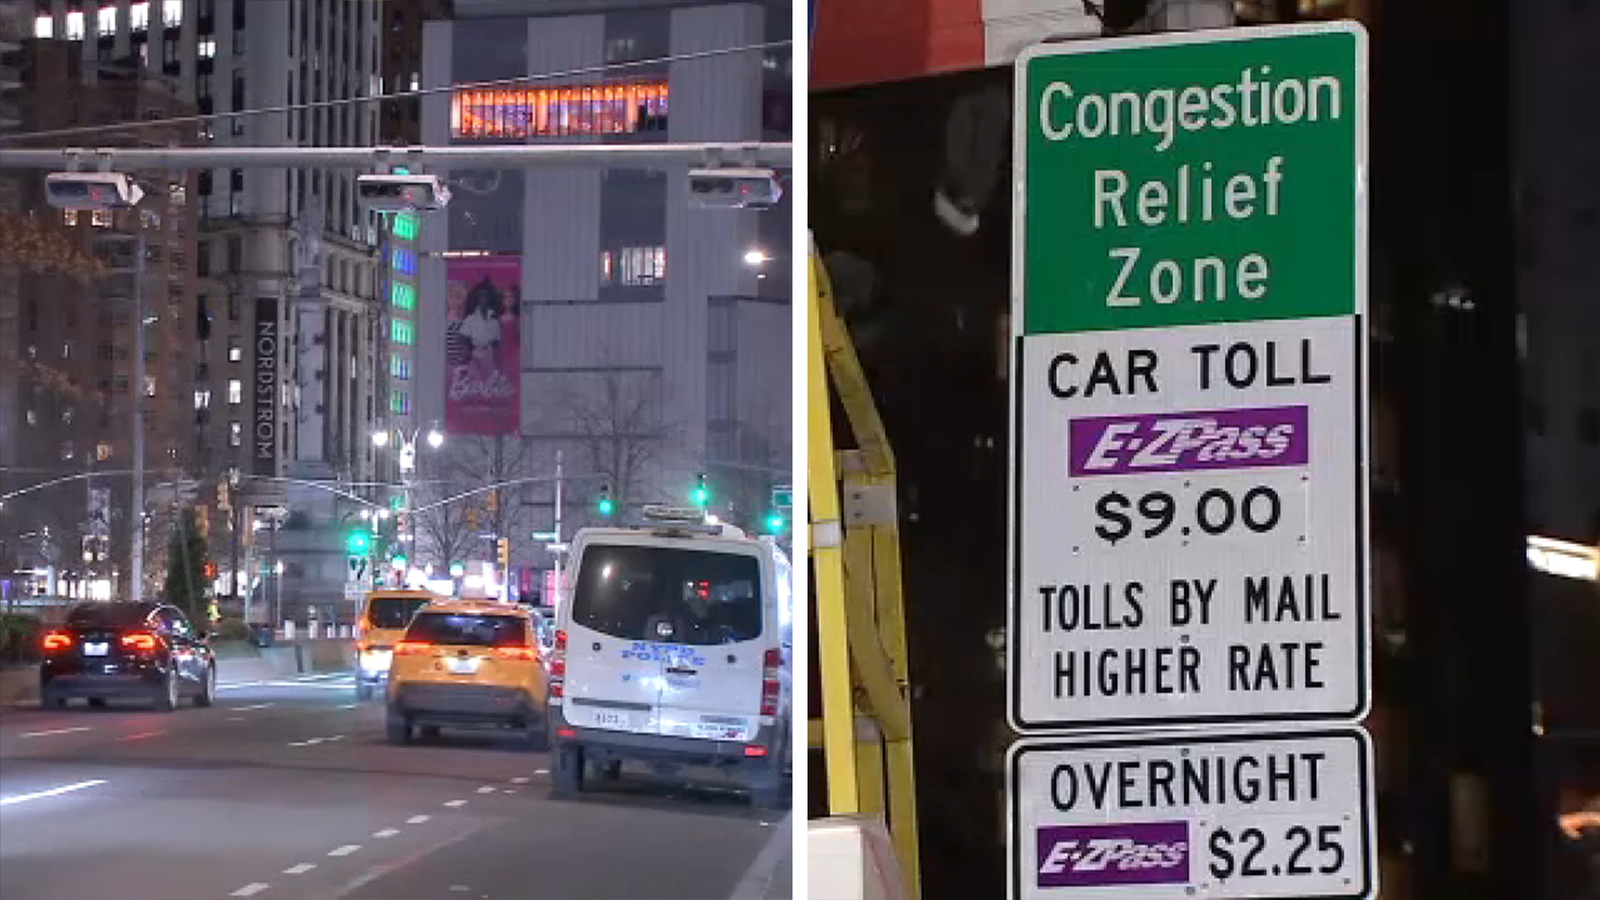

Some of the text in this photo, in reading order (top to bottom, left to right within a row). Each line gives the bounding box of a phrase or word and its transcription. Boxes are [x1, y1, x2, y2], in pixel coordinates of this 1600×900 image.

[1039, 64, 1341, 152] Congestion
[1094, 155, 1284, 229] Relief
[1105, 247, 1270, 308] Zone
[257, 321, 276, 459] NORDSTROM
[449, 364, 514, 401] Barbie
[1048, 338, 1332, 399] CAR TOLL
[1094, 486, 1282, 546] $9.00
[1038, 574, 1341, 633] TOLLS BY MAIL
[1053, 642, 1325, 698] HIGHER RATE
[1050, 753, 1326, 812] OVERNIGHT
[1208, 825, 1345, 884] $2.25
